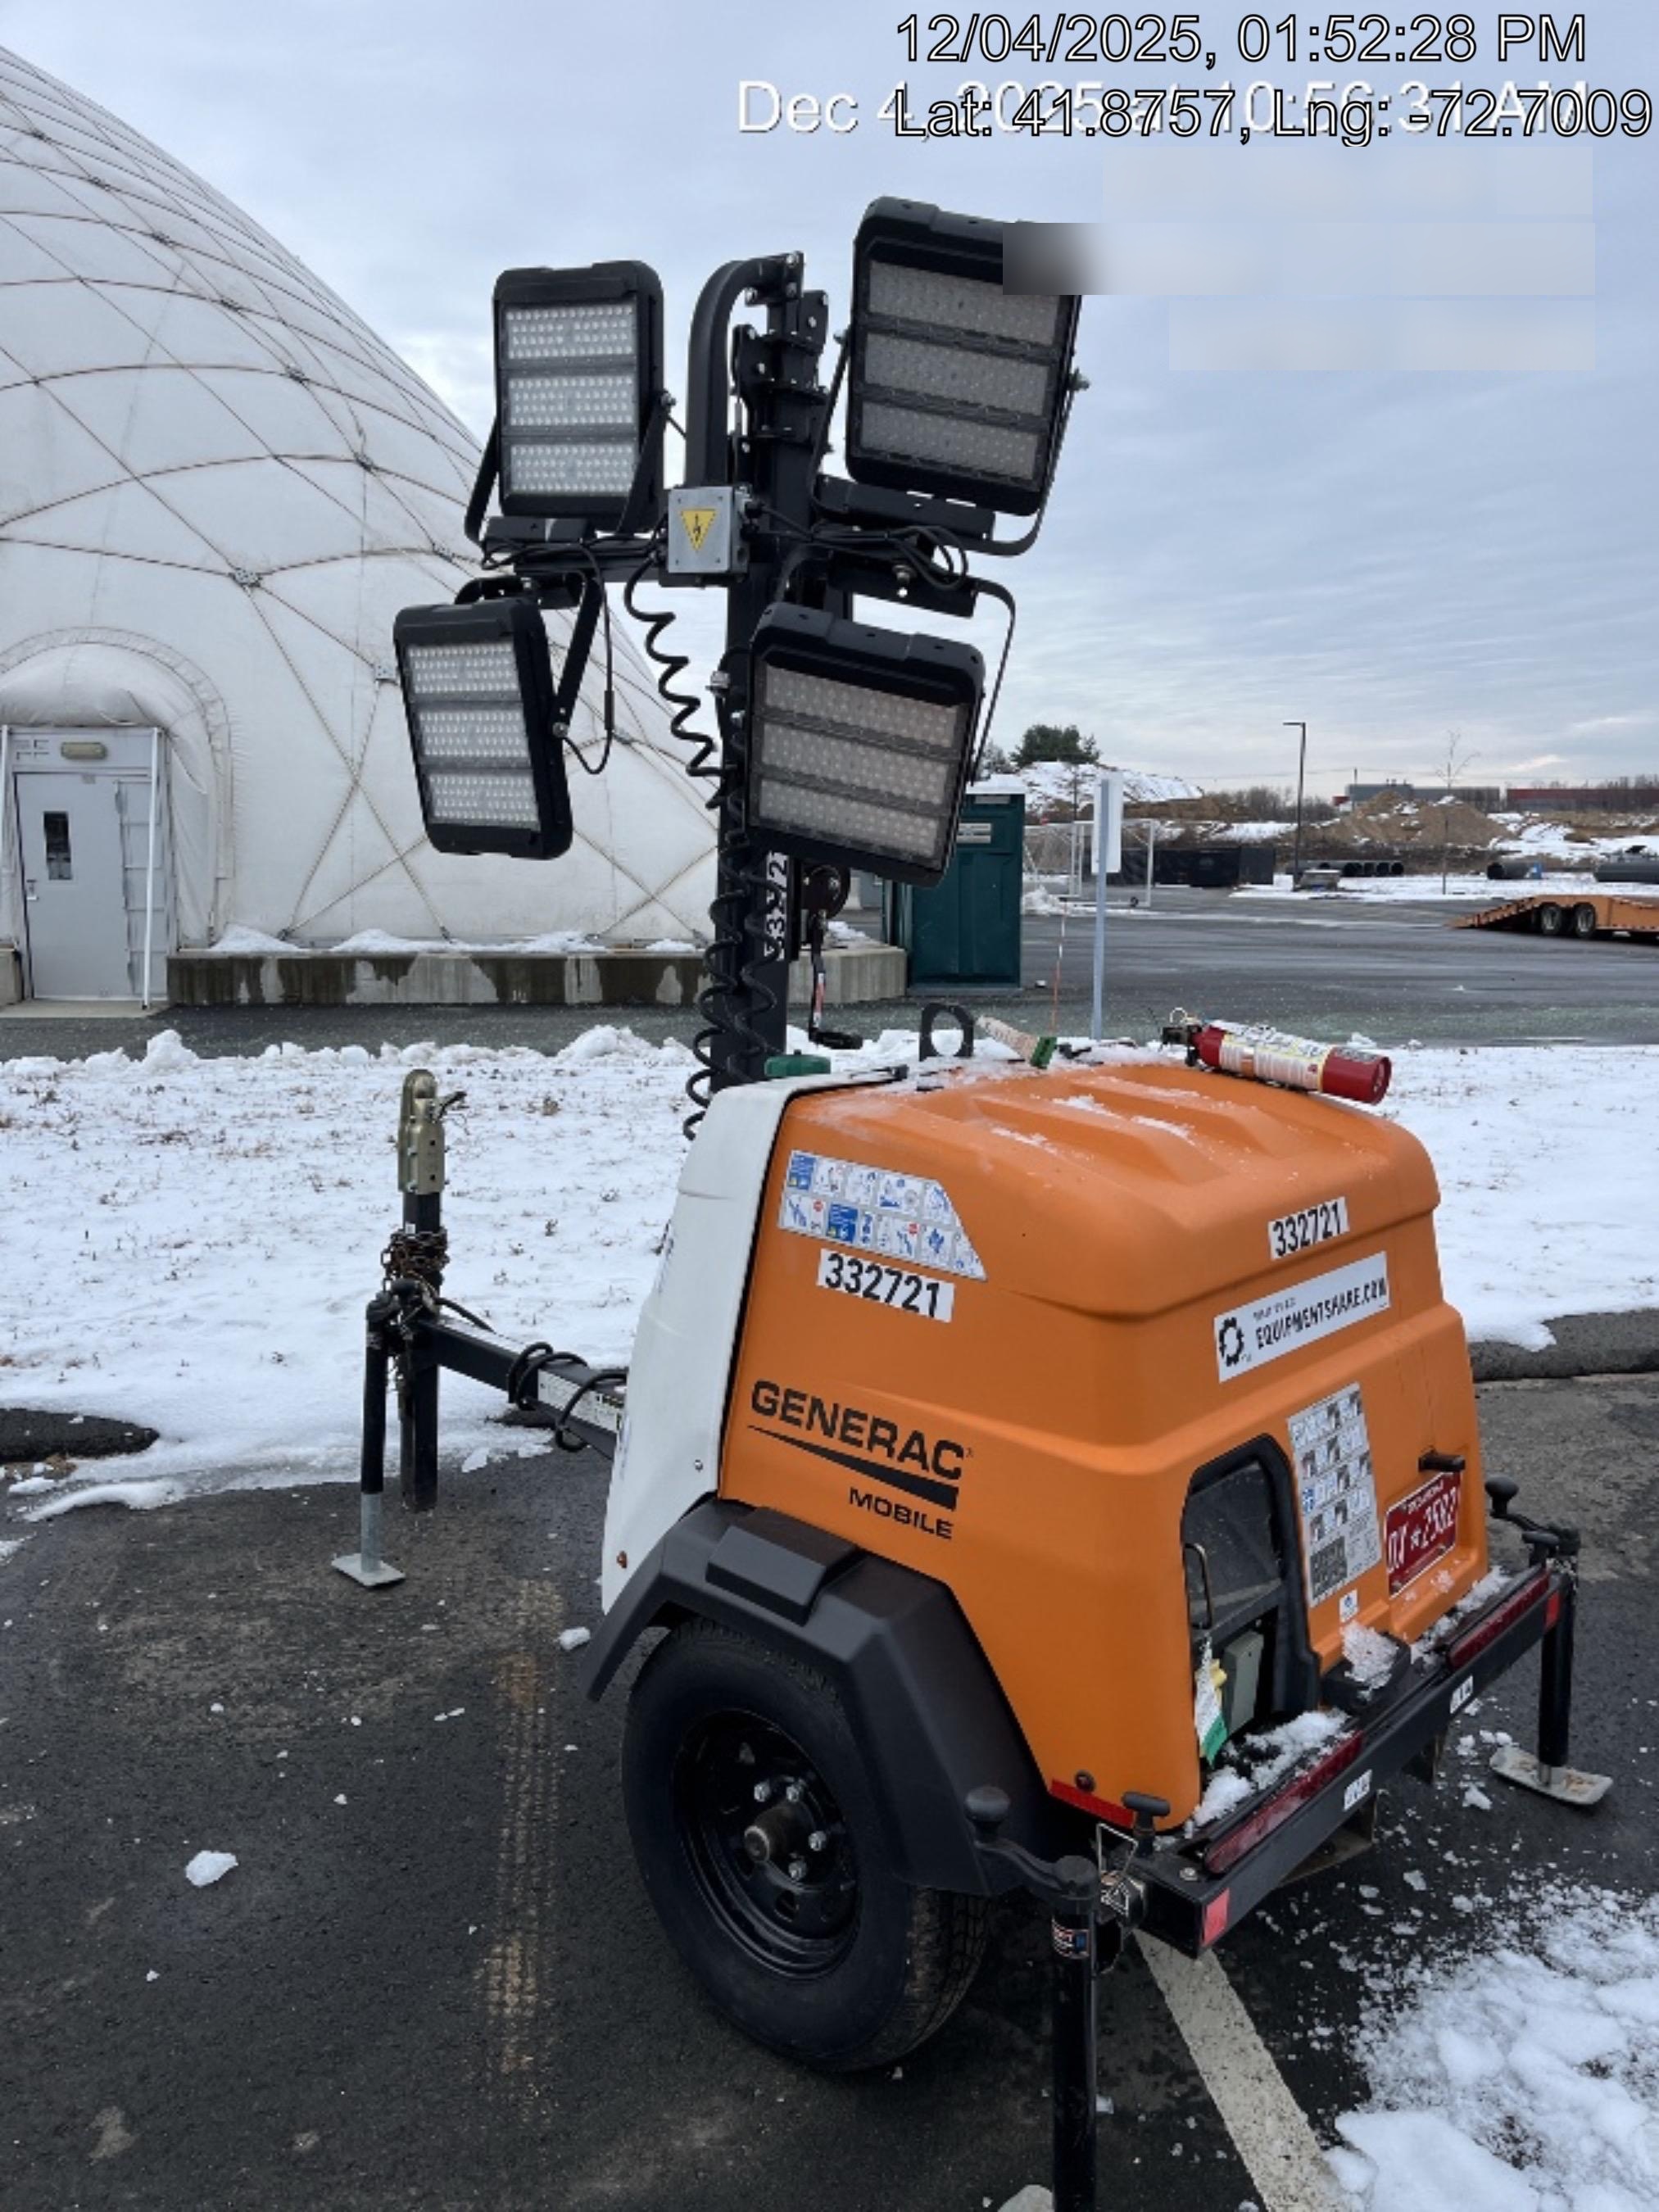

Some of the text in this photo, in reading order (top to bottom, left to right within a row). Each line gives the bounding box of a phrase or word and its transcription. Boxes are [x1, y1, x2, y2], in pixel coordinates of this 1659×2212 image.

[1273, 1201, 1341, 1258] 332721
[825, 1253, 940, 1318] 332721
[1255, 1276, 1387, 1350] EQUIPMENTSHARE.COM
[751, 1380, 964, 1480] GENERAC
[849, 1487, 954, 1540] MOBILE
